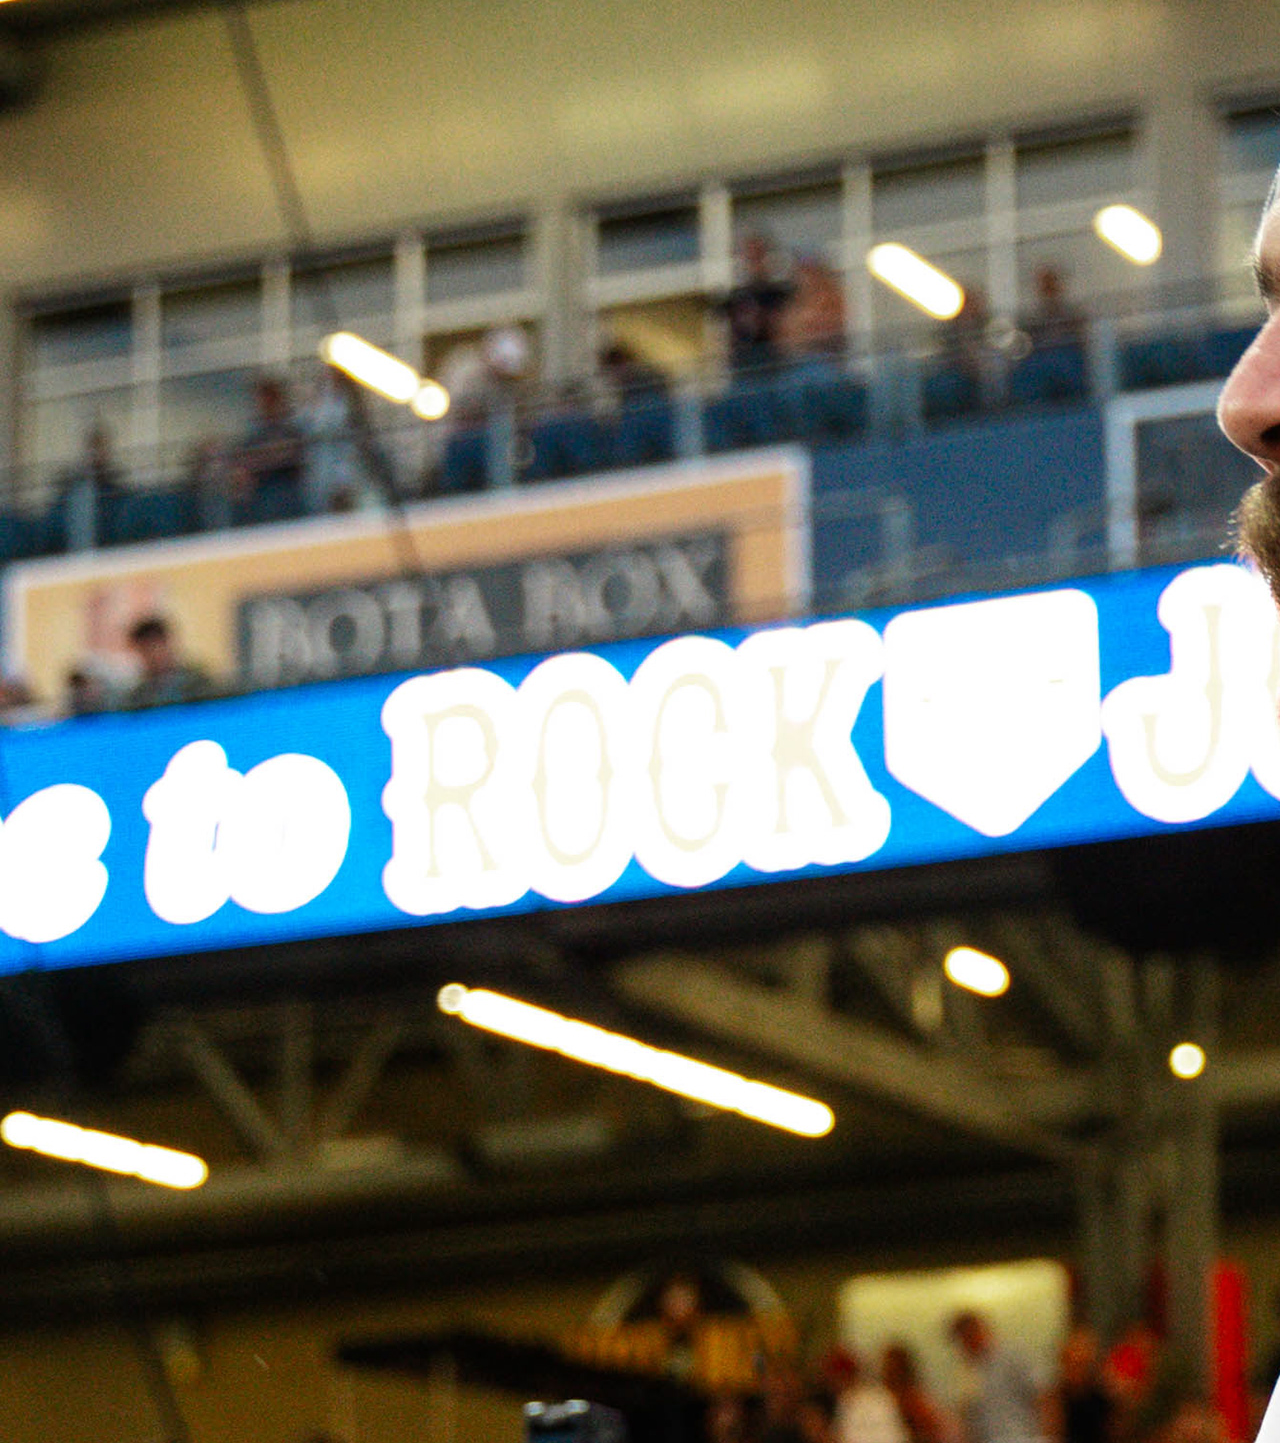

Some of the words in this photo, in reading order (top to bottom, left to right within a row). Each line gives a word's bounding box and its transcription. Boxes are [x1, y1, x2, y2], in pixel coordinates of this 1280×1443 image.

[243, 572, 499, 689] BOTA
[521, 530, 726, 651] BOX
[143, 739, 352, 925] to
[388, 623, 888, 911] ROCK
